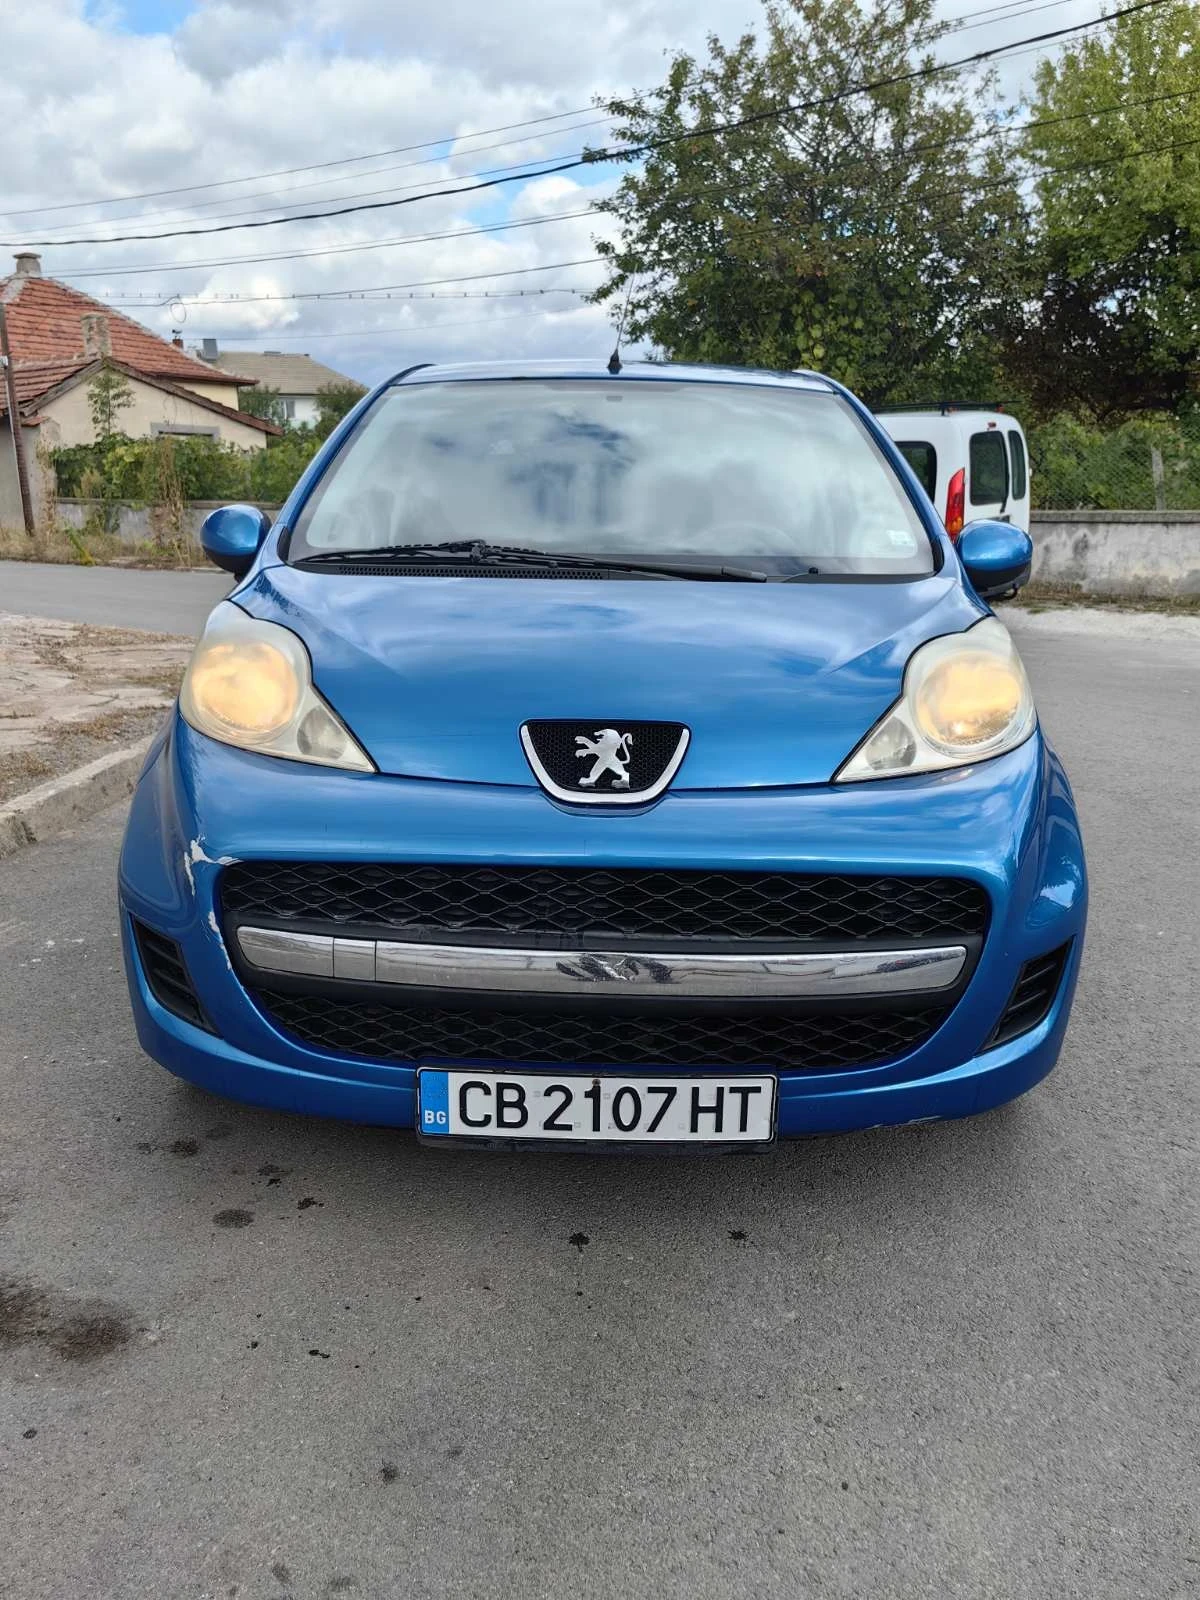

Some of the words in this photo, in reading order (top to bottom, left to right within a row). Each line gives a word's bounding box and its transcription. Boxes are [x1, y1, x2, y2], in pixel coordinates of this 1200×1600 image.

[424, 1111, 446, 1124] BG
[459, 1081, 528, 1128] CB
[543, 1084, 677, 1133] 2107
[690, 1086, 761, 1133] HT
